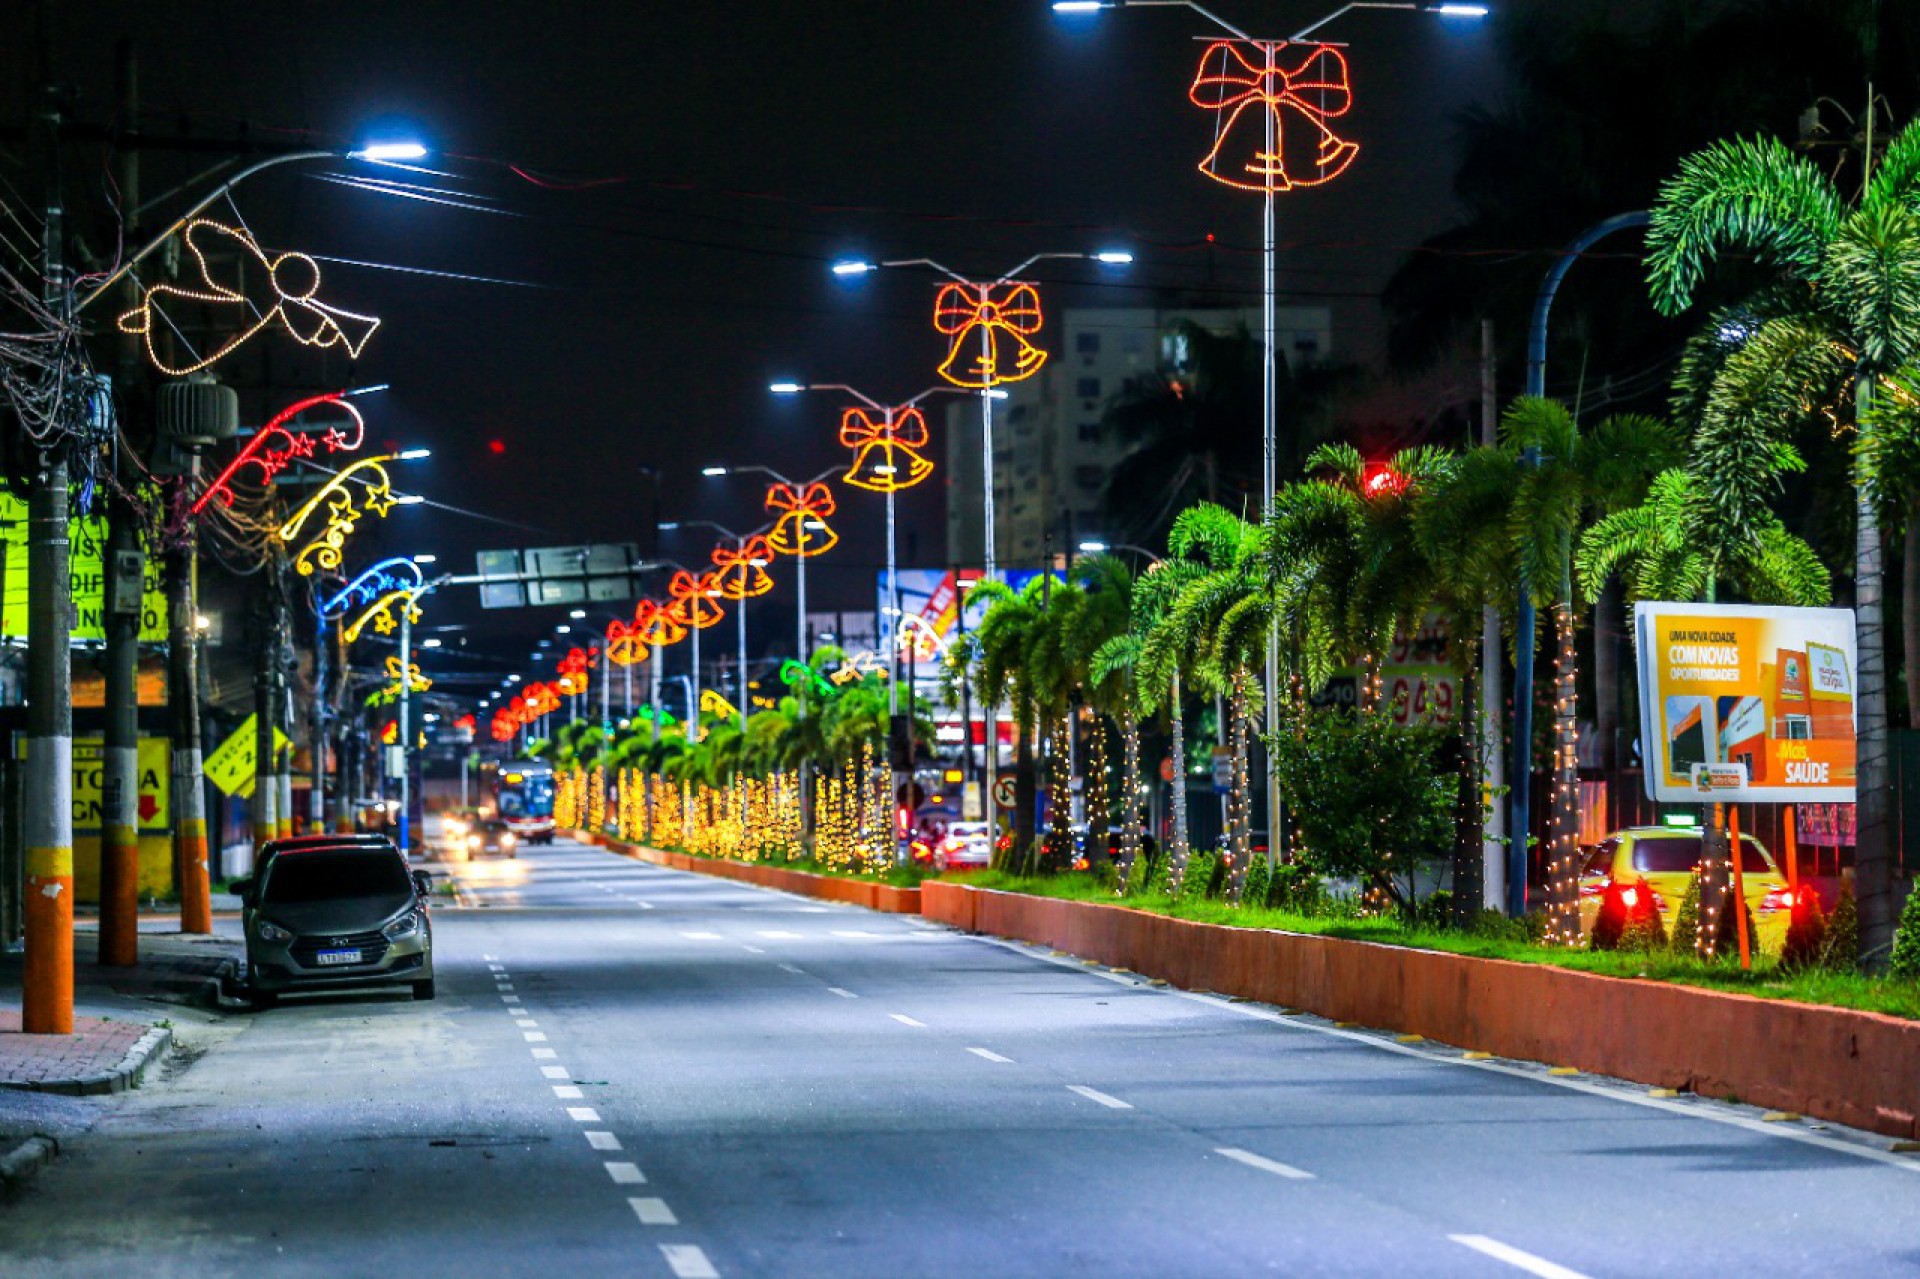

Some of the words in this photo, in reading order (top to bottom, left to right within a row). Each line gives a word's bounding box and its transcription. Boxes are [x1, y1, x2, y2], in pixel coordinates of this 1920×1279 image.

[1669, 630, 1687, 642] UMA
[1669, 645, 1697, 664] COM
[1698, 645, 1739, 665] NOVAS
[1785, 758, 1829, 783] SAÚDE
